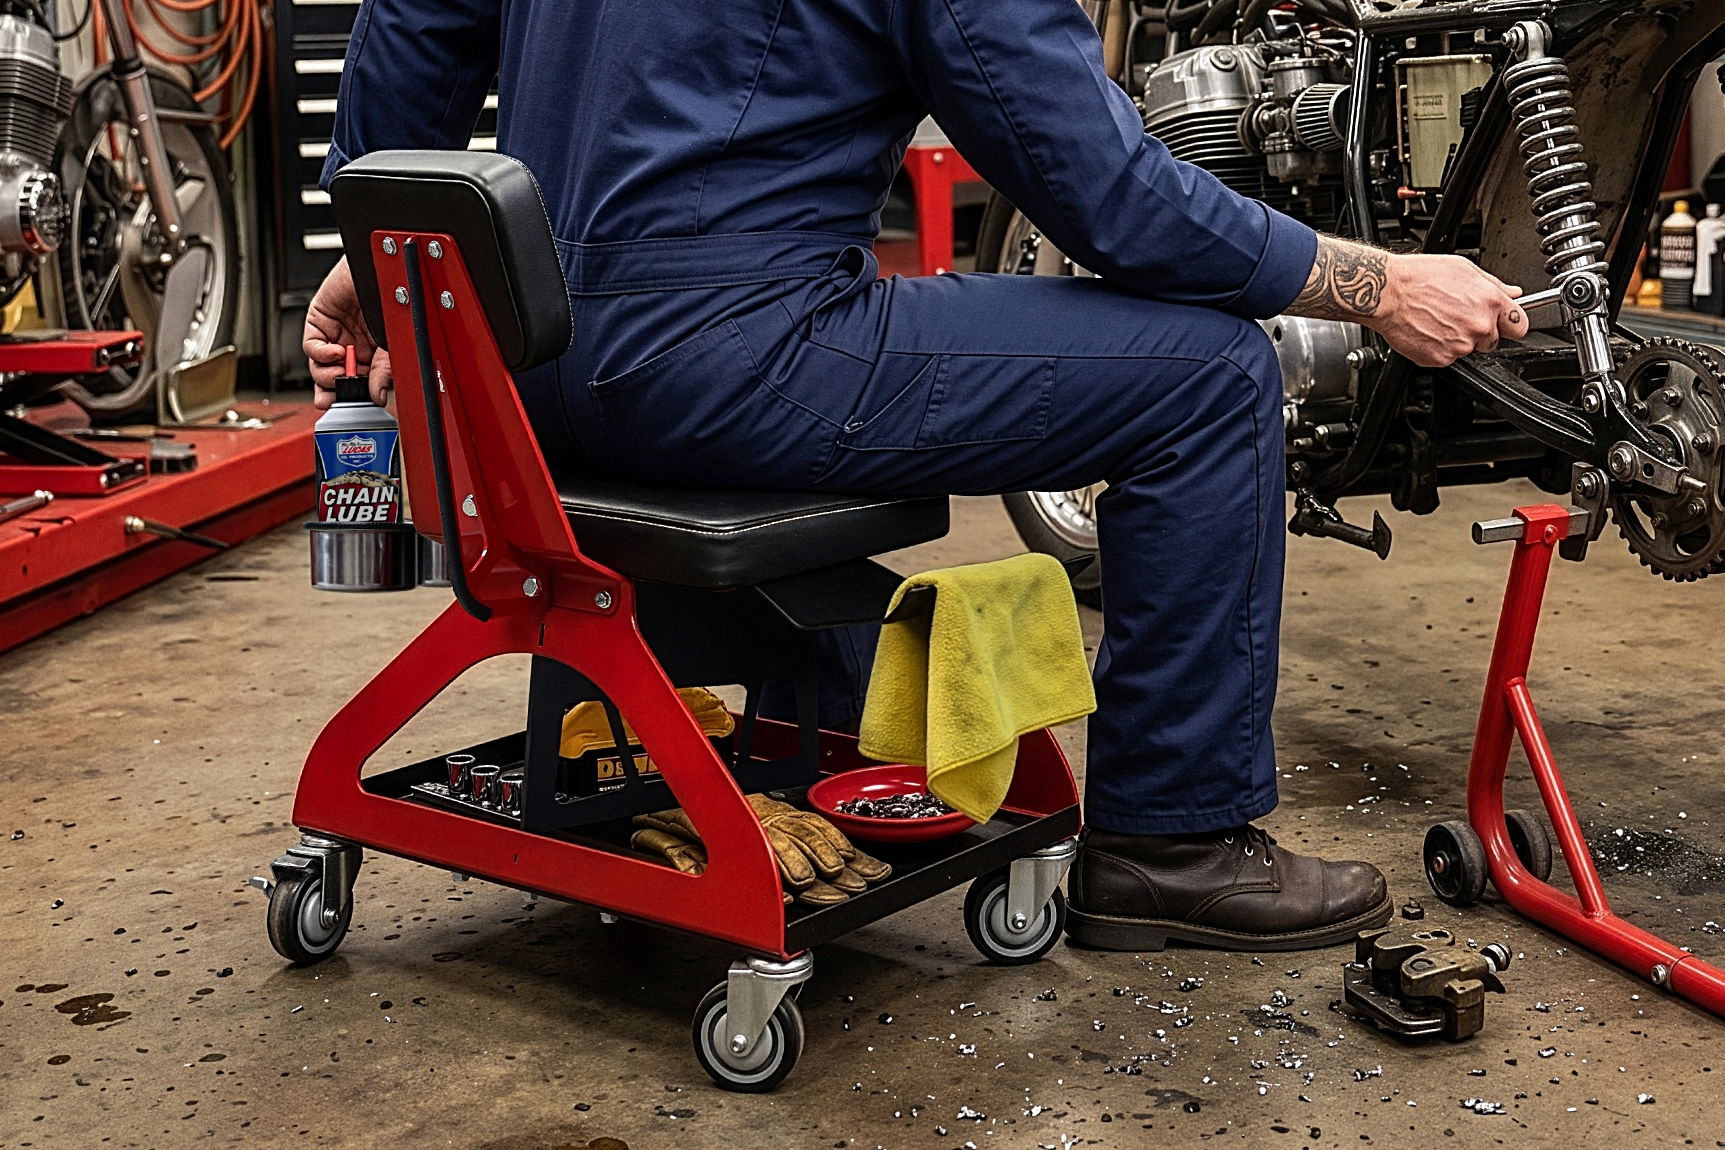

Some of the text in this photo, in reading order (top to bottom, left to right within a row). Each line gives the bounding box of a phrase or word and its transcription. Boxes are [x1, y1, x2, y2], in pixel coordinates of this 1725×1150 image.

[342, 445, 372, 454] LUCAS
[324, 486, 394, 505] CHAIN
[326, 504, 389, 522] LUBE
